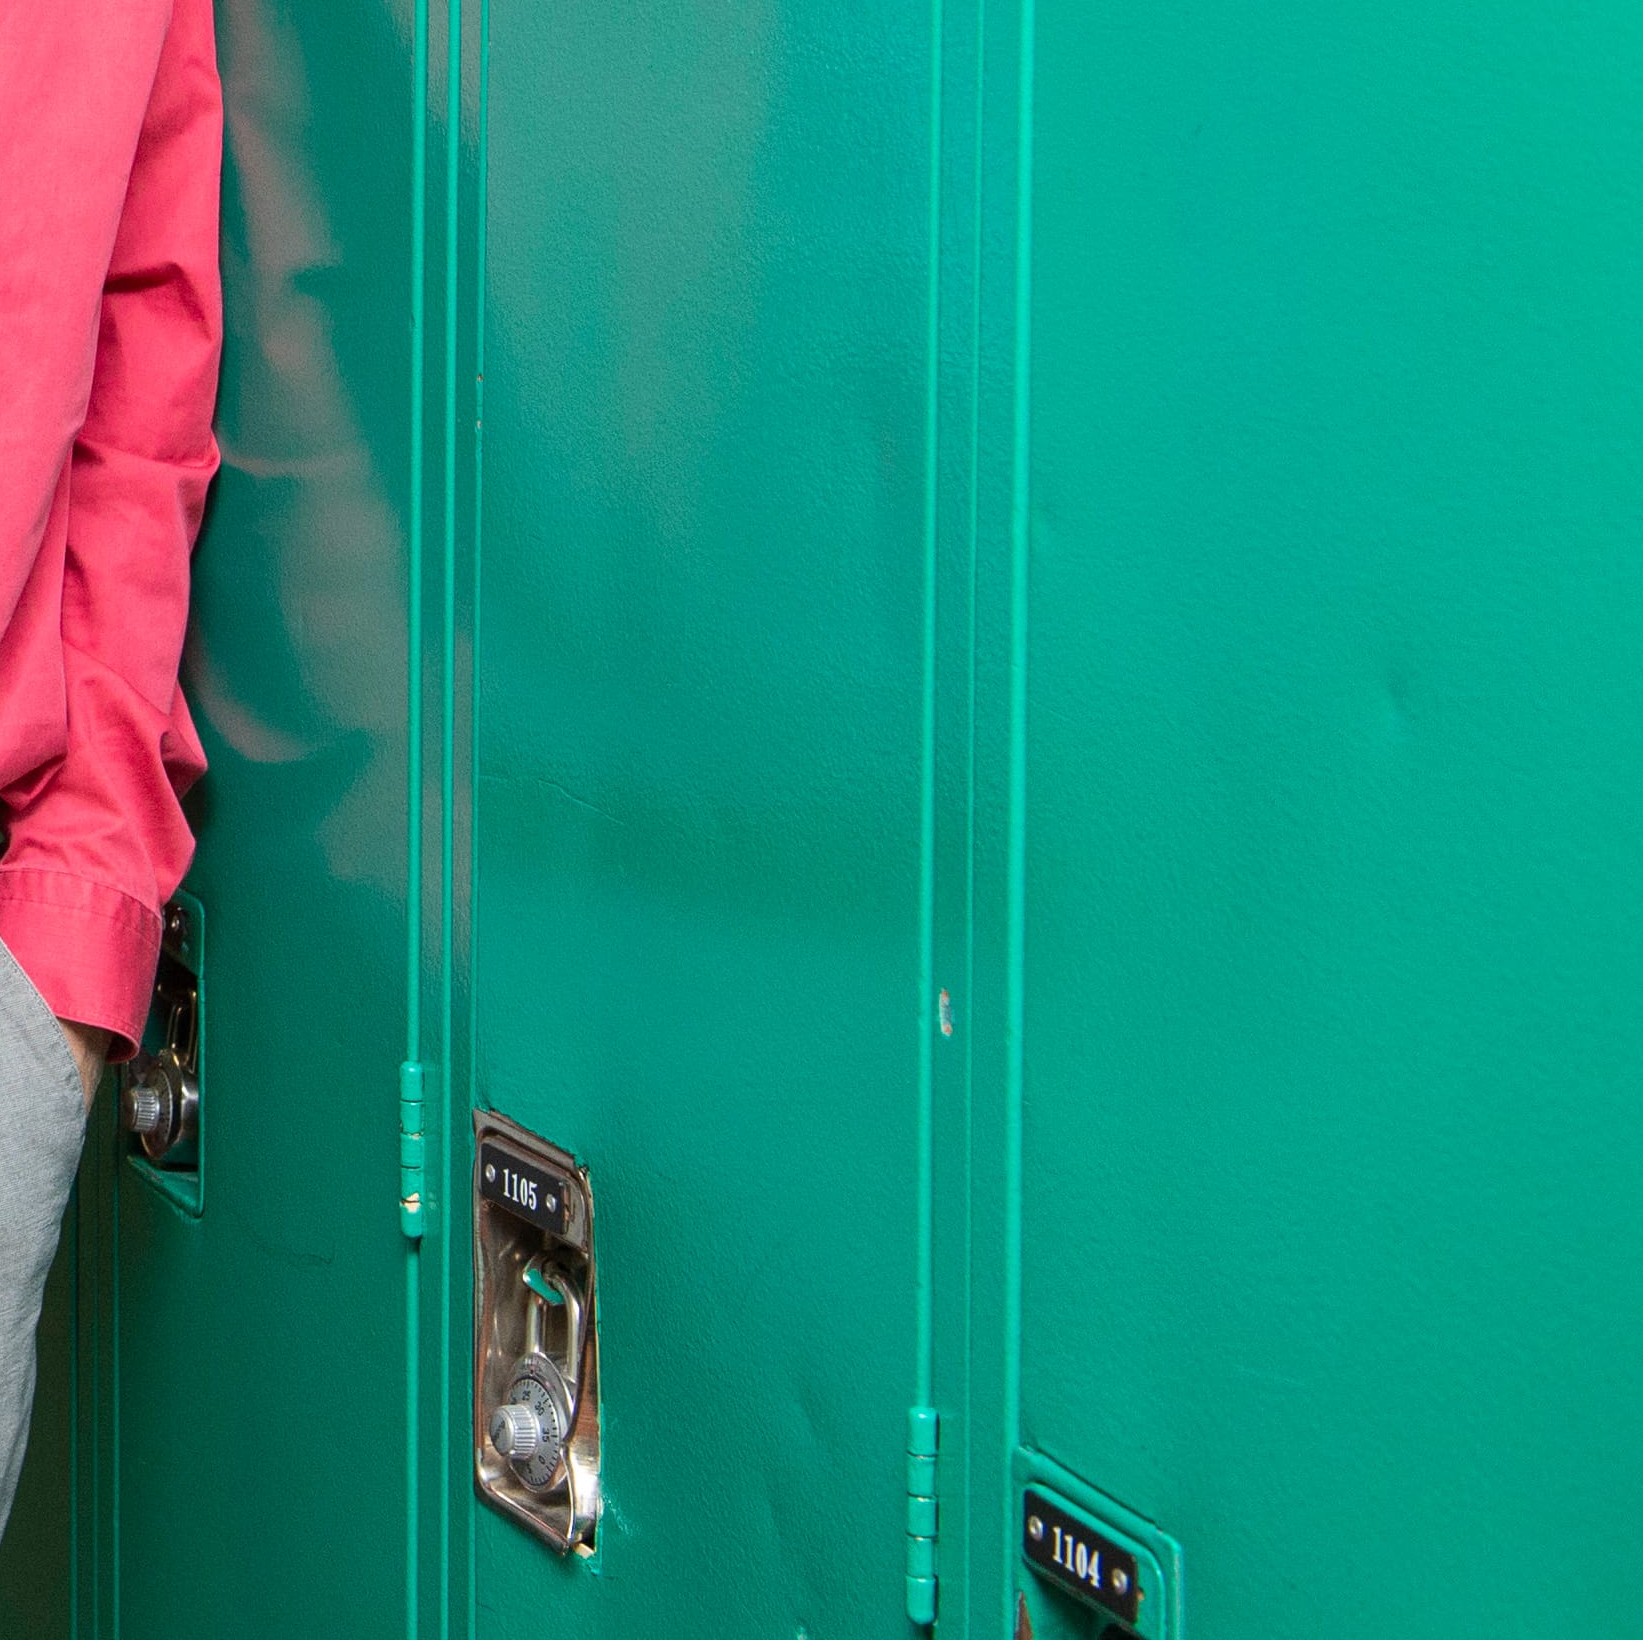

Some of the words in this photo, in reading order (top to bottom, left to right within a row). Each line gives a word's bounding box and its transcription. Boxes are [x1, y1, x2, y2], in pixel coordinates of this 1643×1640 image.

[503, 1168, 538, 1211] 1105
[535, 1401, 545, 1416] 30
[542, 1427, 550, 1442] 35
[538, 1455, 546, 1465] 0
[1052, 1525, 1100, 1588] 1104
